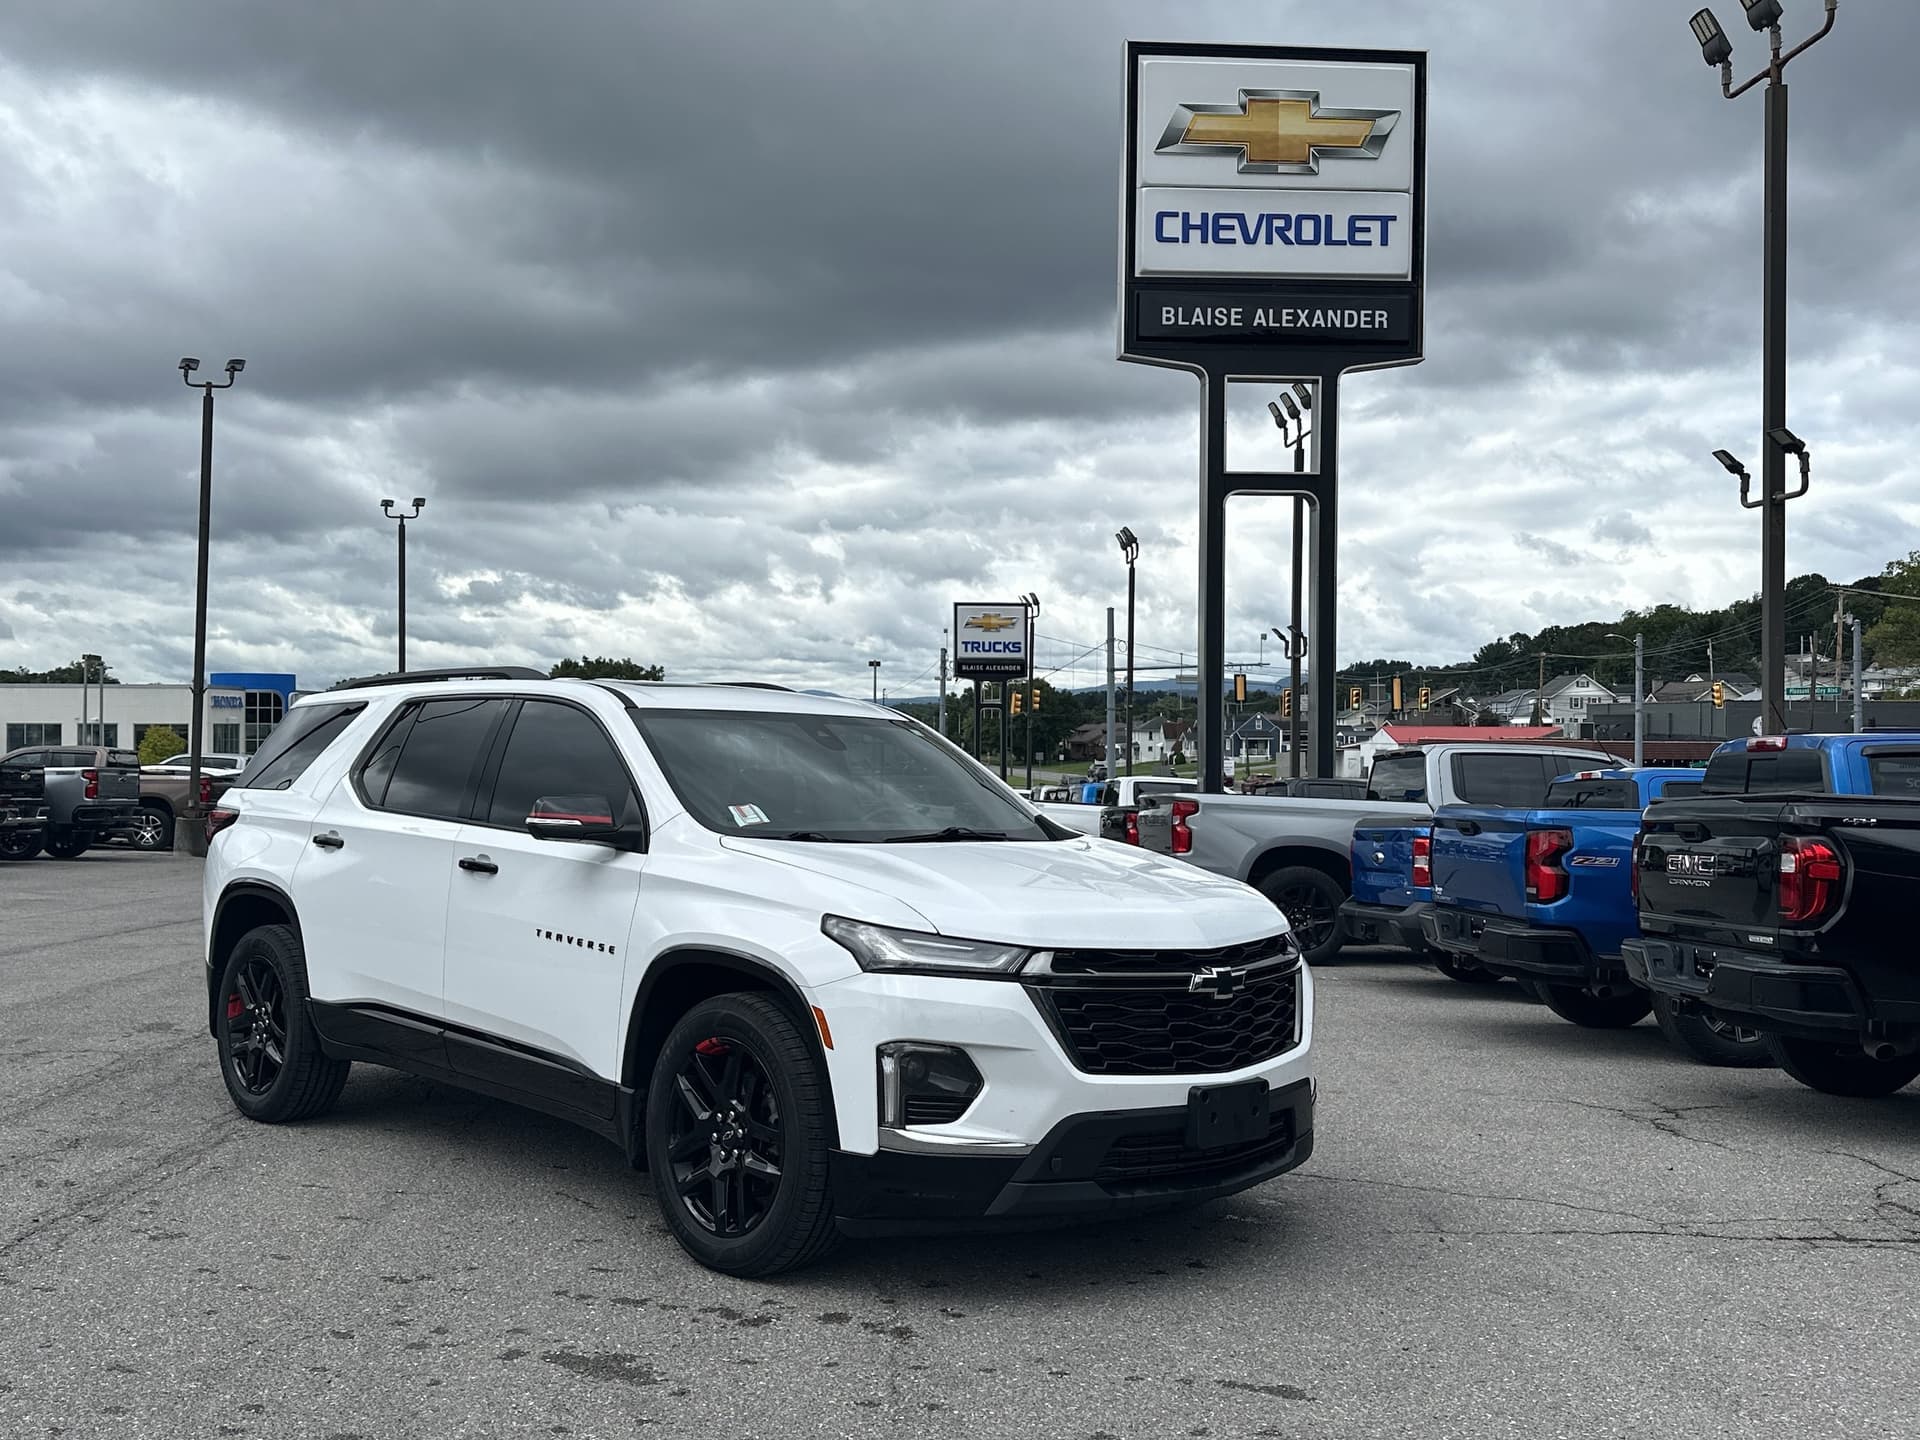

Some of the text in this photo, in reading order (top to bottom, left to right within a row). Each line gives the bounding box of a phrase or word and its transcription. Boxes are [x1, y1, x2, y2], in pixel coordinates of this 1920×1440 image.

[1155, 211, 1397, 246] CHEVROLET
[1161, 307, 1389, 329] BLAISE ALEXANDER
[961, 641, 1021, 653] TRUCKS
[211, 695, 244, 708] HONDA
[1666, 855, 1714, 875] GMC
[1669, 879, 1710, 887] CANYON
[536, 928, 616, 955] TRAVERSE
